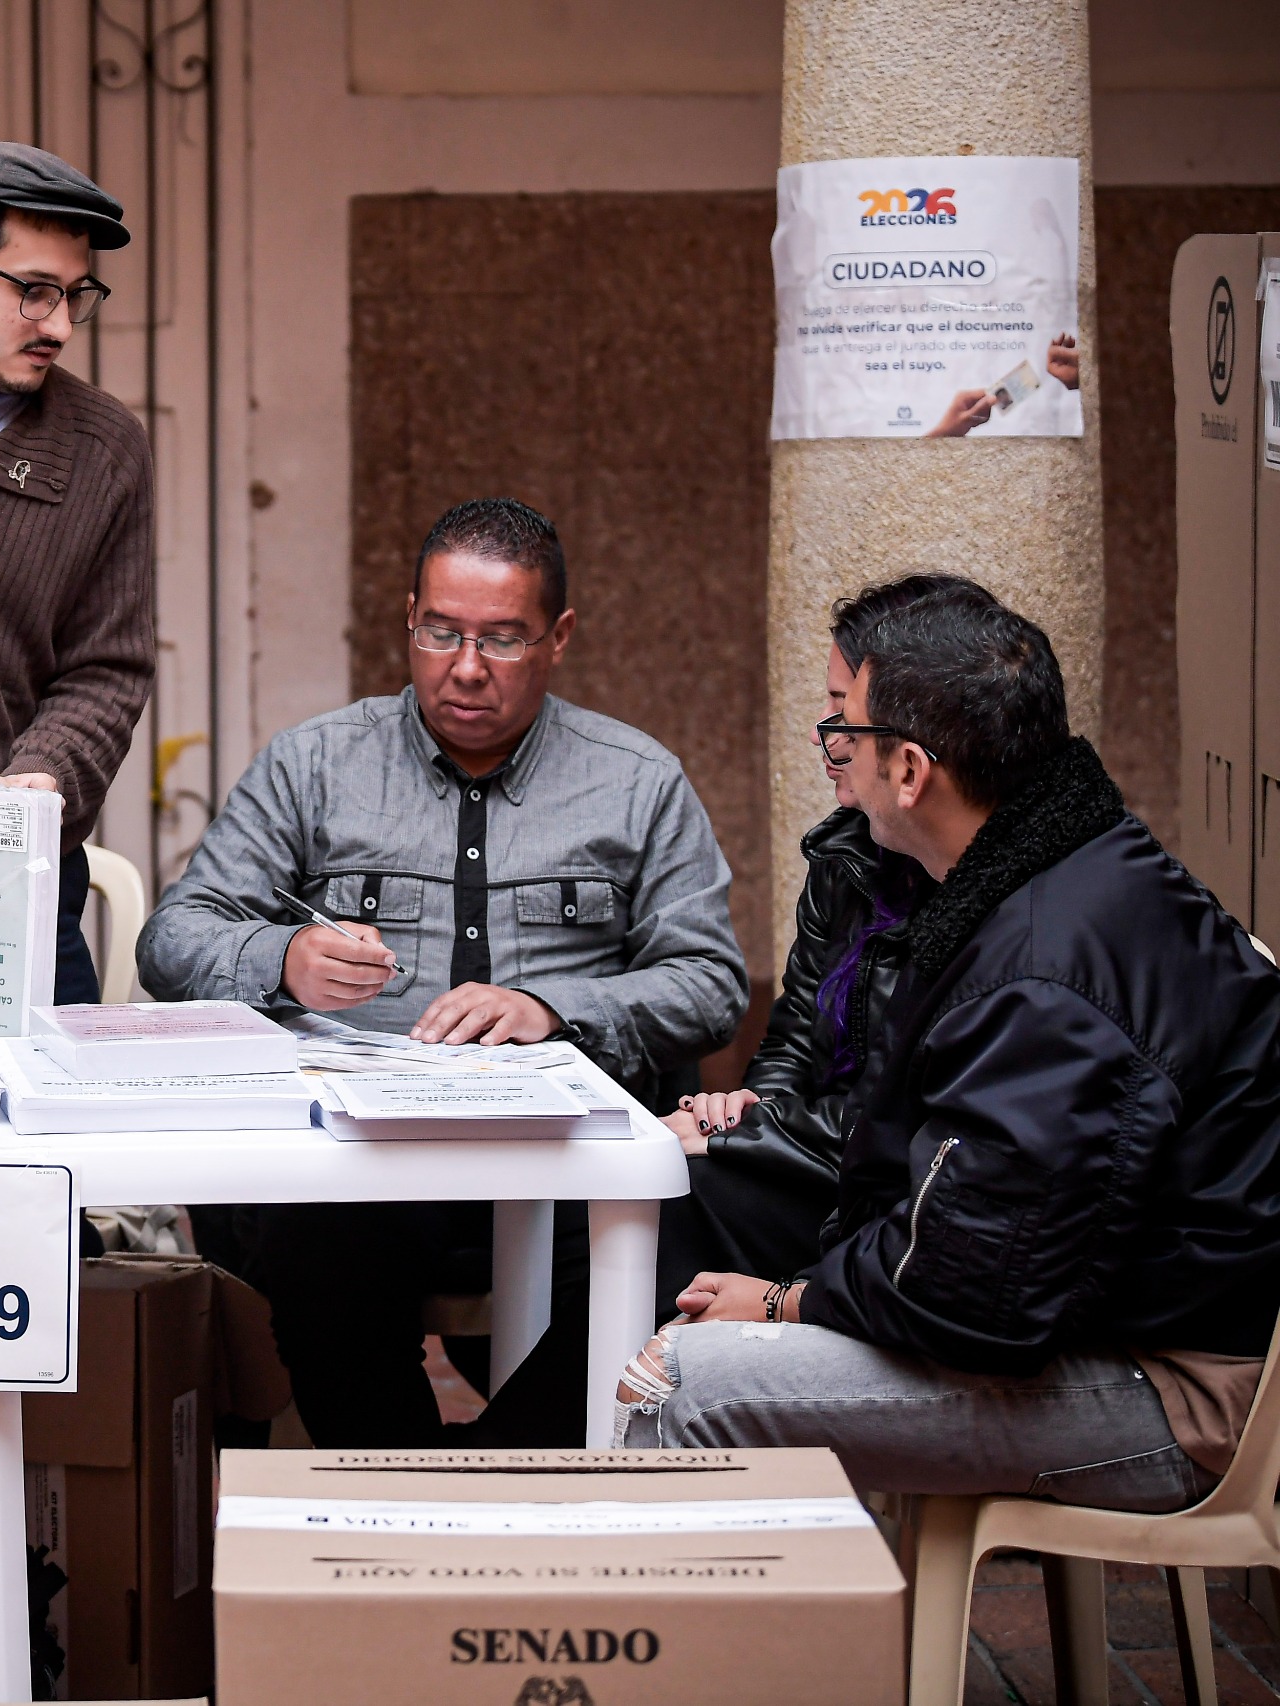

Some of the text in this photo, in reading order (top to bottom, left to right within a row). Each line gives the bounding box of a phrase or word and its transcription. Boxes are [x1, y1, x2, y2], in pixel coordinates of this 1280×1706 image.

[857, 188, 957, 216] 2026
[861, 214, 957, 227] ELECCIONES
[832, 260, 986, 281] CIUDADANO
[835, 304, 849, 314] de
[853, 303, 896, 316] ejercer
[901, 303, 916, 314] su
[920, 301, 977, 313] derecho
[812, 323, 843, 335] olvide
[846, 321, 902, 333] verificar
[906, 321, 934, 334] que
[938, 320, 951, 331] el
[955, 319, 1034, 332] documento
[833, 342, 881, 355] entrega
[885, 341, 897, 351] el
[900, 339, 946, 353] jurado
[949, 339, 967, 351] de
[970, 339, 1026, 351] votación
[865, 359, 946, 373] sea el suyo.
[338, 1455, 497, 1463] DEPOSITE
[507, 1455, 547, 1463] SU
[557, 1455, 645, 1463] VOTO
[429, 1567, 524, 1578] VOTO
[535, 1567, 579, 1578] SU
[590, 1567, 768, 1579] DEPOSITE
[450, 1627, 661, 1665] SENADO
